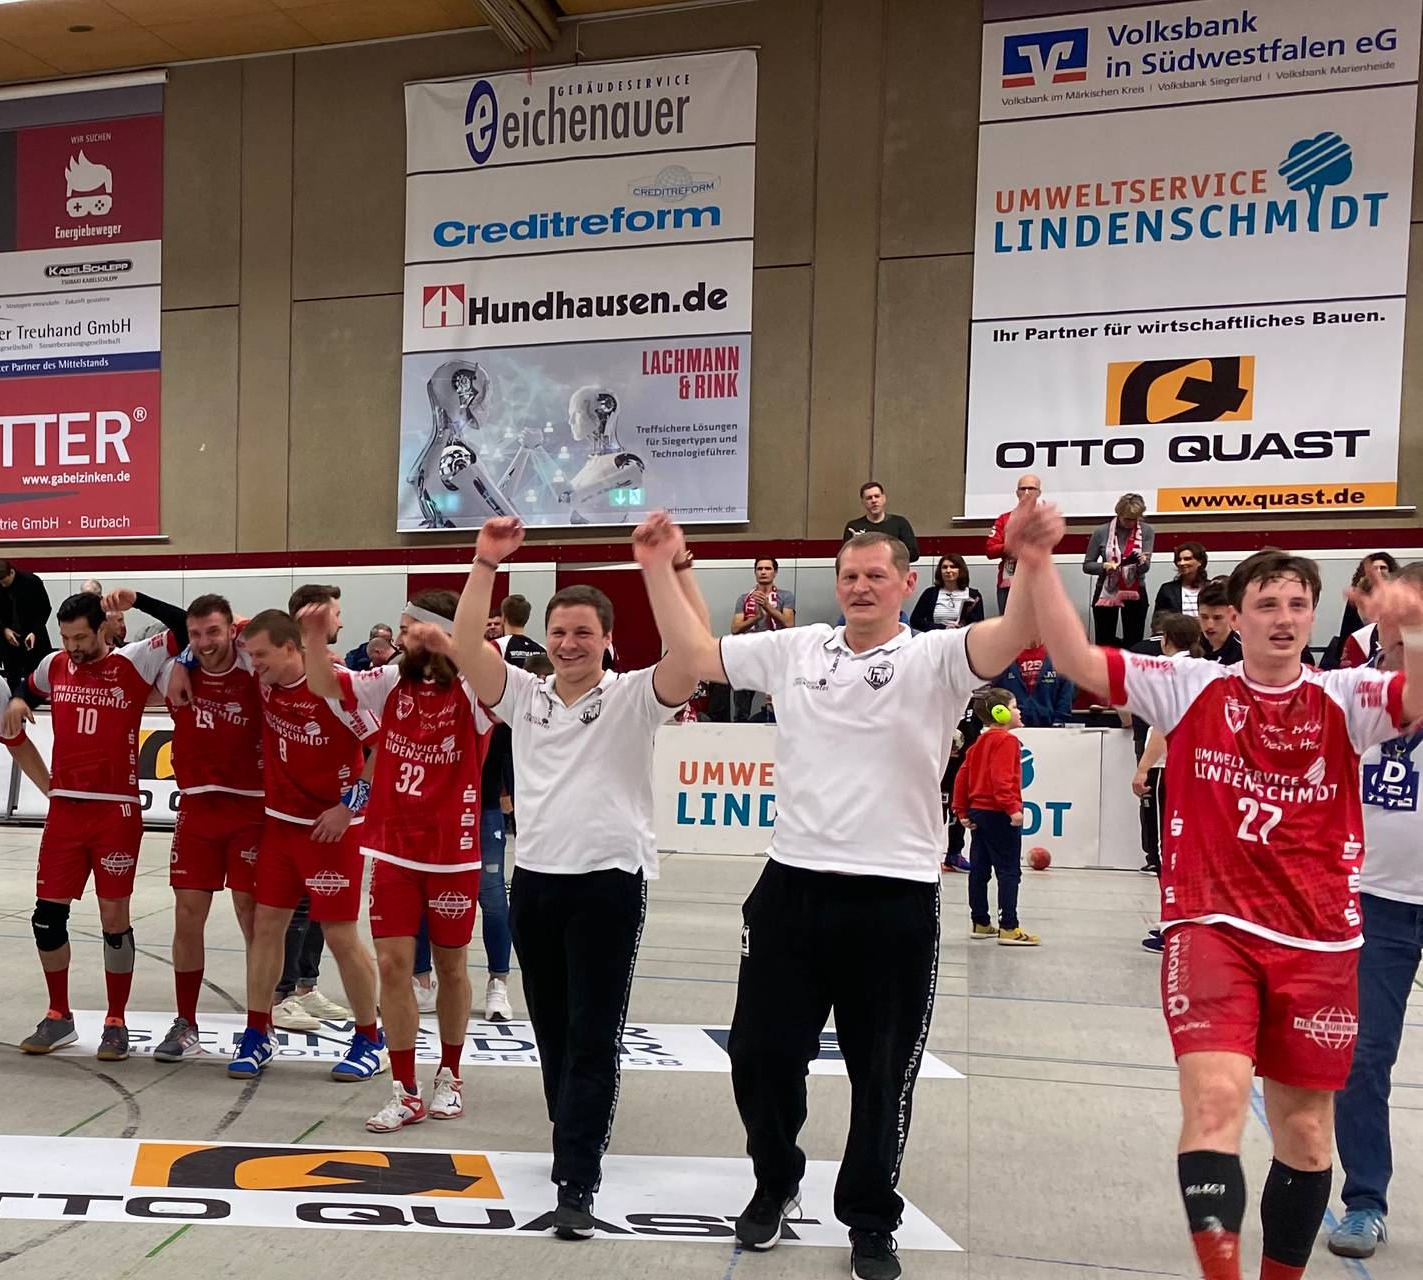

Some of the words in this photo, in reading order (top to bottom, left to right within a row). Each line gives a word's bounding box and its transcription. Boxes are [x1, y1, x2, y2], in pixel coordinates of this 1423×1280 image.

[1107, 10, 1257, 47] Volksbank
[1106, 55, 1132, 79] in
[1141, 35, 1345, 76] Südwestfalen
[1355, 28, 1397, 54] eG
[557, 73, 691, 97] GEBÄUDESERVICE
[1001, 92, 1049, 106] Volksbank
[1065, 86, 1119, 100] Märkischen
[1121, 84, 1145, 95] Kreis
[1158, 77, 1207, 91] Volksbank
[1209, 73, 1262, 88] Siegerland
[1276, 68, 1327, 81] Volksbank
[1330, 61, 1395, 75] Marienheide
[502, 85, 691, 149] eichenauer
[70, 134, 84, 145] WIR
[85, 132, 112, 143] SUCHEN
[633, 181, 715, 198] CREDITREFORM
[995, 169, 1268, 214] UMWELTSERVICE
[54, 223, 122, 241] Energiebeweger
[433, 205, 722, 248] Creditreform
[995, 192, 1389, 253] LINDENSCHMIDT
[468, 282, 728, 326] Hundhausen.de
[17, 321, 82, 340] Treuhand
[87, 318, 131, 335] GmbH
[993, 328, 1019, 343] Ihr
[1025, 325, 1099, 341] Partner
[1103, 322, 1132, 337] für
[1137, 313, 1305, 335] wirtschaftliches
[1312, 310, 1386, 326] Bauen.
[11, 360, 41, 372] Partner
[42, 360, 56, 370] des
[58, 357, 109, 369] Mittelstands
[642, 346, 740, 376] LACHMANN
[679, 375, 691, 400] &
[694, 373, 739, 399] RINK
[636, 424, 691, 434] Treffsichere
[693, 422, 738, 433] Lösungen
[645, 437, 660, 446] für
[662, 436, 717, 447] Siegertypen
[719, 434, 738, 444] und
[651, 447, 737, 459] Technologieführer.
[995, 437, 1145, 469] OTTO
[1168, 429, 1370, 464] QUAST
[22, 472, 131, 487] www.gabelzinken.de
[1181, 487, 1366, 510] www.quast.de
[21, 517, 59, 529] GmbH
[80, 515, 130, 529] Burbach
[53, 691, 132, 709] LINDENSCHMID
[76, 707, 98, 735] 10
[278, 738, 288, 763] 8
[395, 762, 425, 797] 32
[119, 803, 132, 818] 10
[1236, 797, 1283, 845] 27
